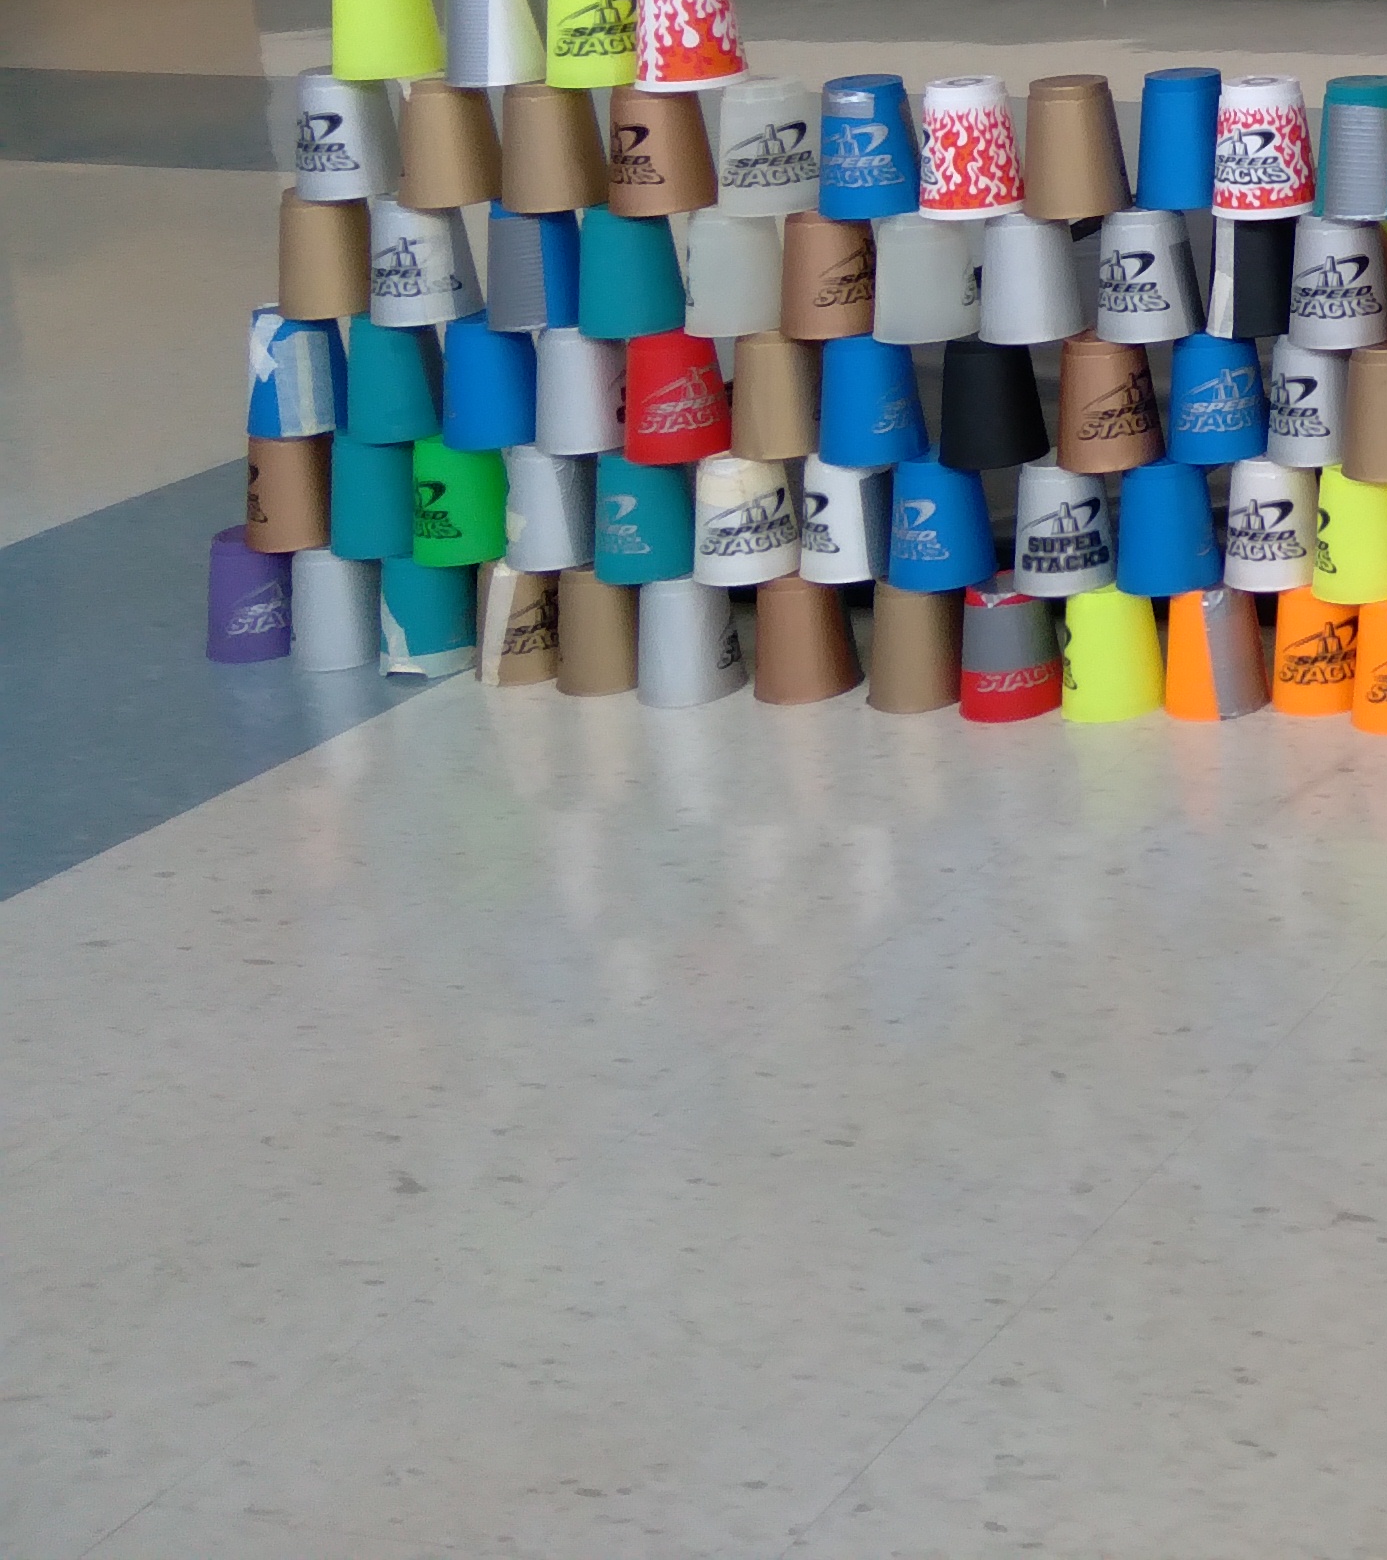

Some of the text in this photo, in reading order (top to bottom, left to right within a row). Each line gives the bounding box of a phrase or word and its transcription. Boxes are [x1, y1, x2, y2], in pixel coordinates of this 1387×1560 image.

[573, 23, 636, 37] SPEE
[736, 151, 812, 168] SPEED
[1299, 286, 1372, 302] SPEED
[718, 515, 792, 538] SPEED
